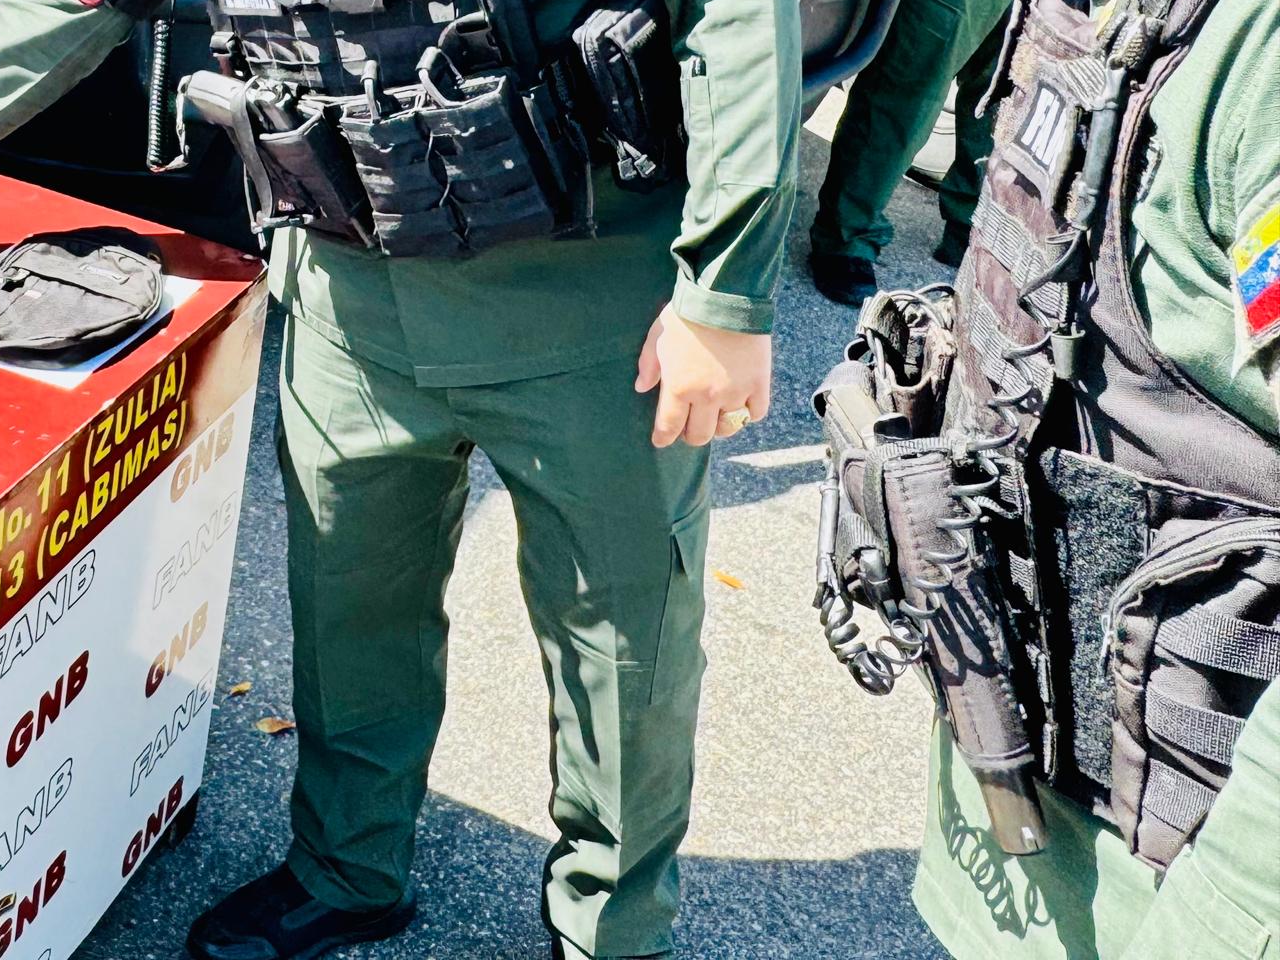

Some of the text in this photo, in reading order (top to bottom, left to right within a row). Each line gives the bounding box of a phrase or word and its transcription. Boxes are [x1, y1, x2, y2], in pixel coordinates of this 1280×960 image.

[38, 451, 71, 506] 11
[83, 352, 188, 482] (ZULIA)
[169, 412, 236, 504] GNB
[36, 401, 188, 580] (CABIMAS)
[152, 492, 238, 610] FANB
[145, 600, 209, 699] GNB
[5, 650, 90, 769] GNB
[129, 668, 214, 798] FANB
[120, 775, 185, 879] GNB
